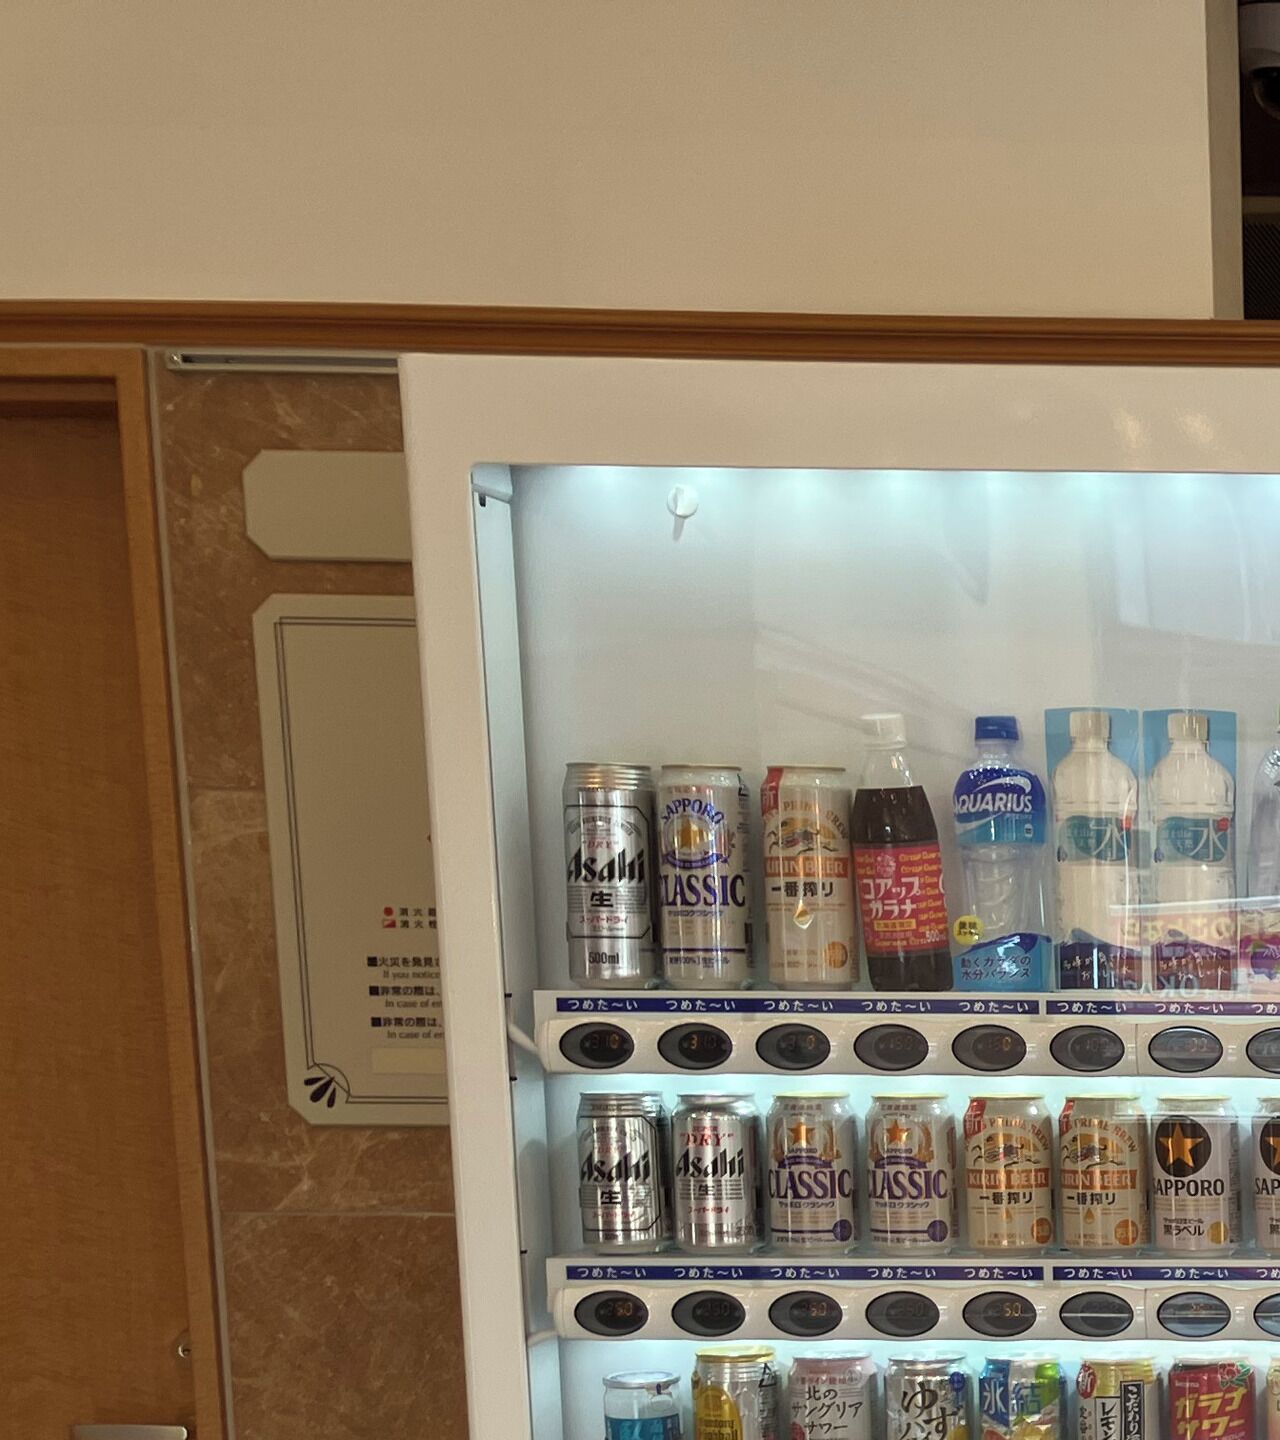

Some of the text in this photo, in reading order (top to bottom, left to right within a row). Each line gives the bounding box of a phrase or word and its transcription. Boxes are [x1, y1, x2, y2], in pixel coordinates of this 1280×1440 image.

[661, 798, 725, 825] SAPPORO
[567, 848, 645, 884] Asahi
[771, 882, 834, 897] 一番搾り
[862, 878, 922, 898] コアップ
[590, 890, 614, 908] 生
[868, 900, 918, 919] ガラナ
[588, 951, 620, 965] 500ml
[580, 1150, 651, 1183] Asahi
[676, 1147, 745, 1179] Asahi
[768, 1169, 852, 1199] CLASSIC
[600, 1190, 622, 1205] 生
[979, 1192, 1033, 1206] 一番搾り
[1066, 1192, 1116, 1206] 一番搾り
[1163, 1224, 1205, 1237] 黒ラベル
[806, 1385, 838, 1401] 北の
[791, 1401, 863, 1419] サングリア
[1175, 1386, 1248, 1419] ガラナ
[804, 1421, 848, 1434] サワー
[1176, 1416, 1246, 1440] サワー
